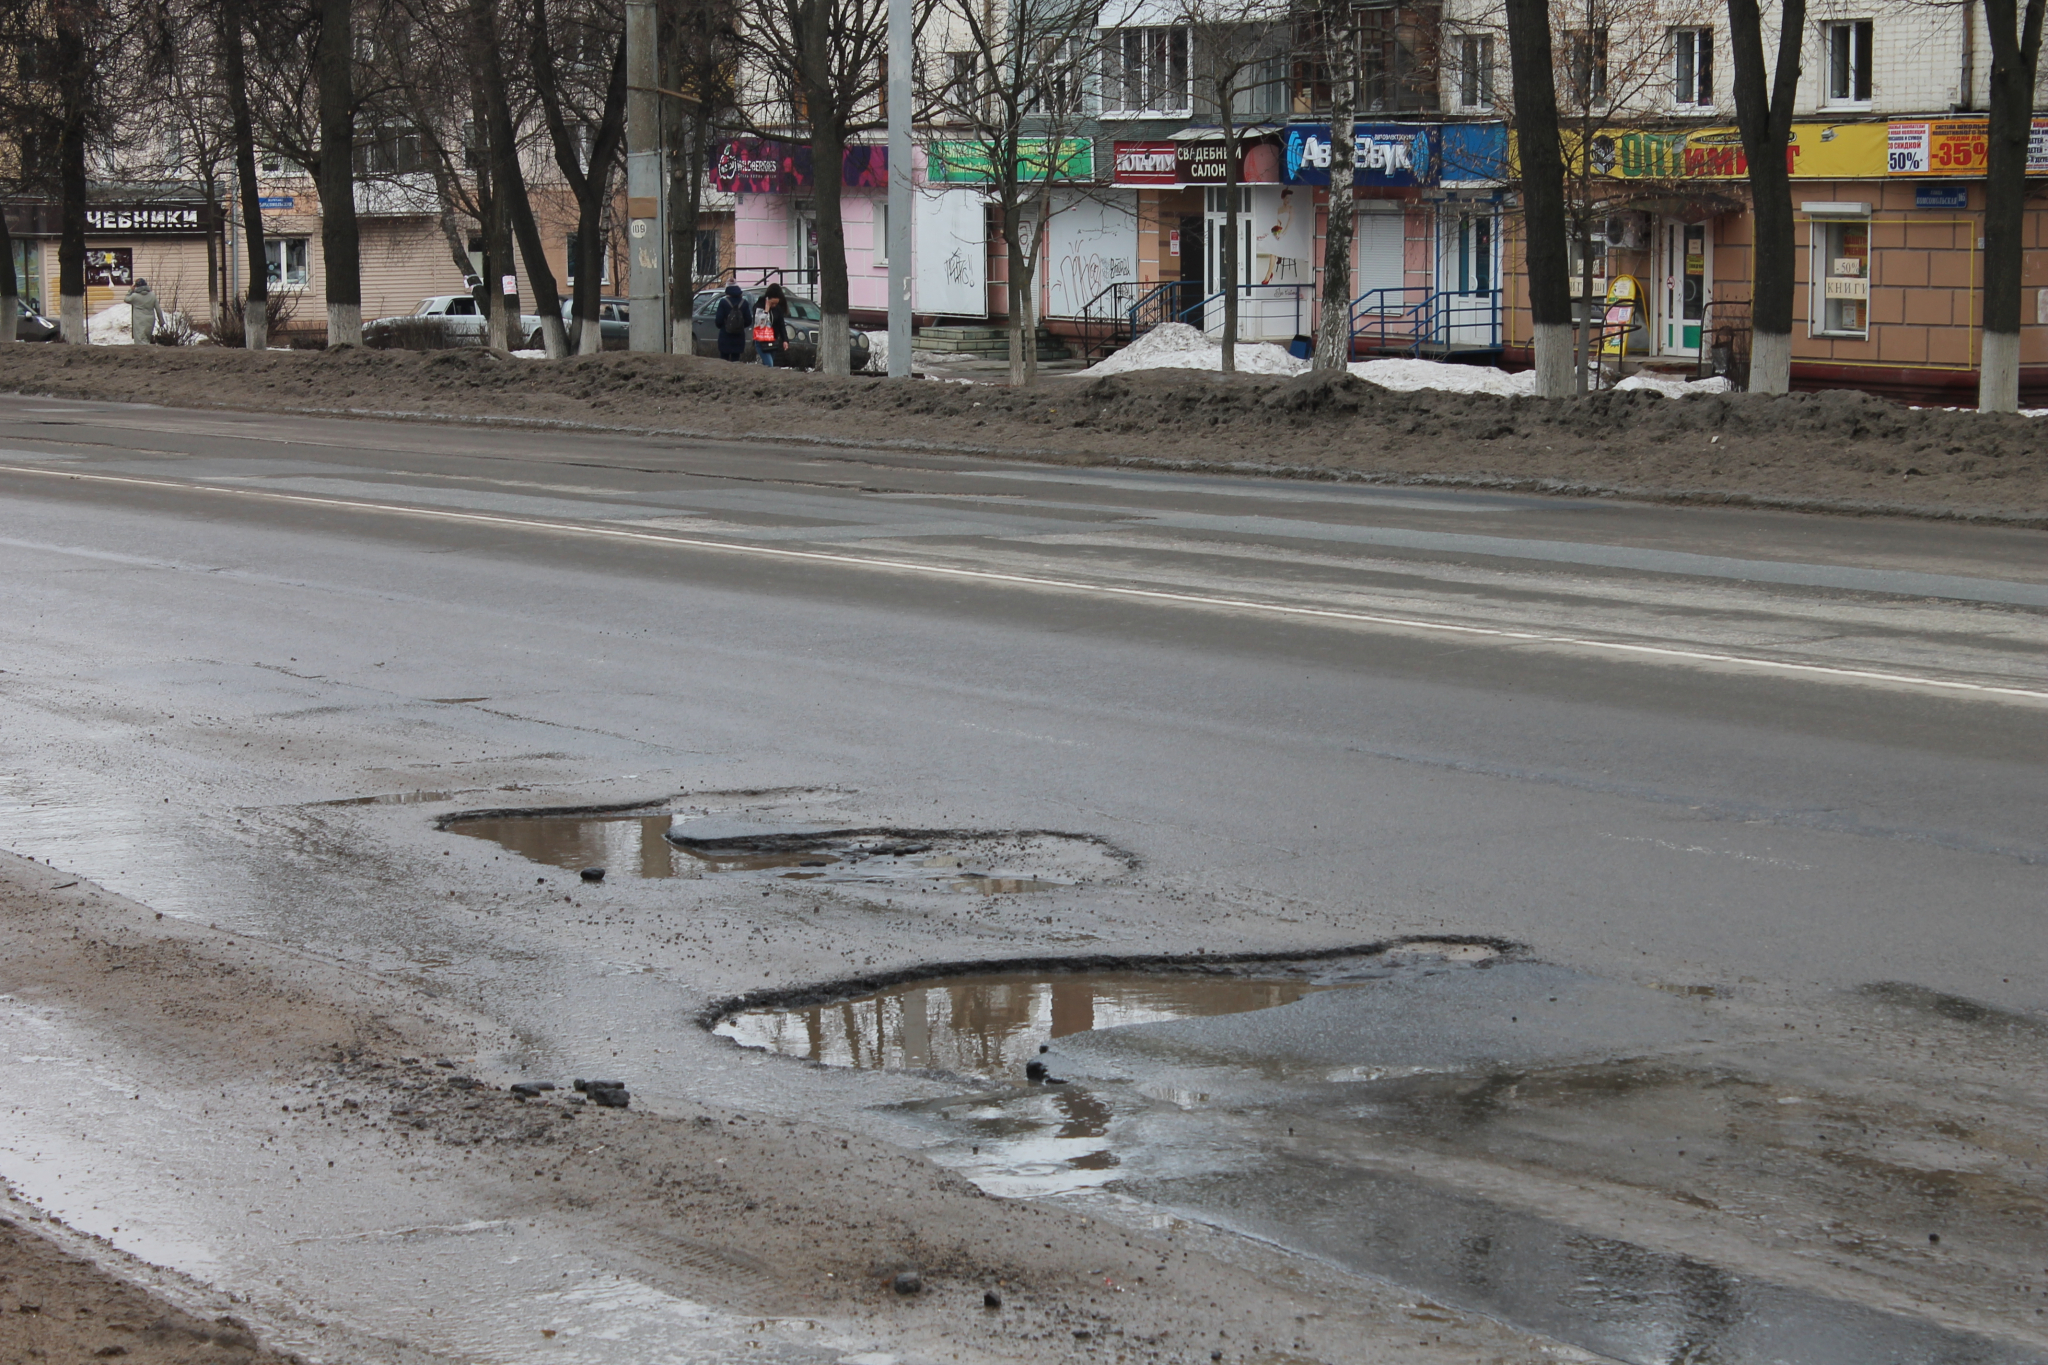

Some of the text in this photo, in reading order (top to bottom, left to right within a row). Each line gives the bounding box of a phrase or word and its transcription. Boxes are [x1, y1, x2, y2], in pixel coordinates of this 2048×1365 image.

[1894, 141, 1922, 150] СКИДКОЙ
[1622, 133, 1800, 177] ОПТИМИТ
[1932, 142, 1988, 166] -35%
[1191, 164, 1226, 177] САЛОН
[85, 210, 198, 229] ЧЕБНИКИ
[632, 224, 646, 233] 109
[1827, 282, 1868, 294] КНИГИ
